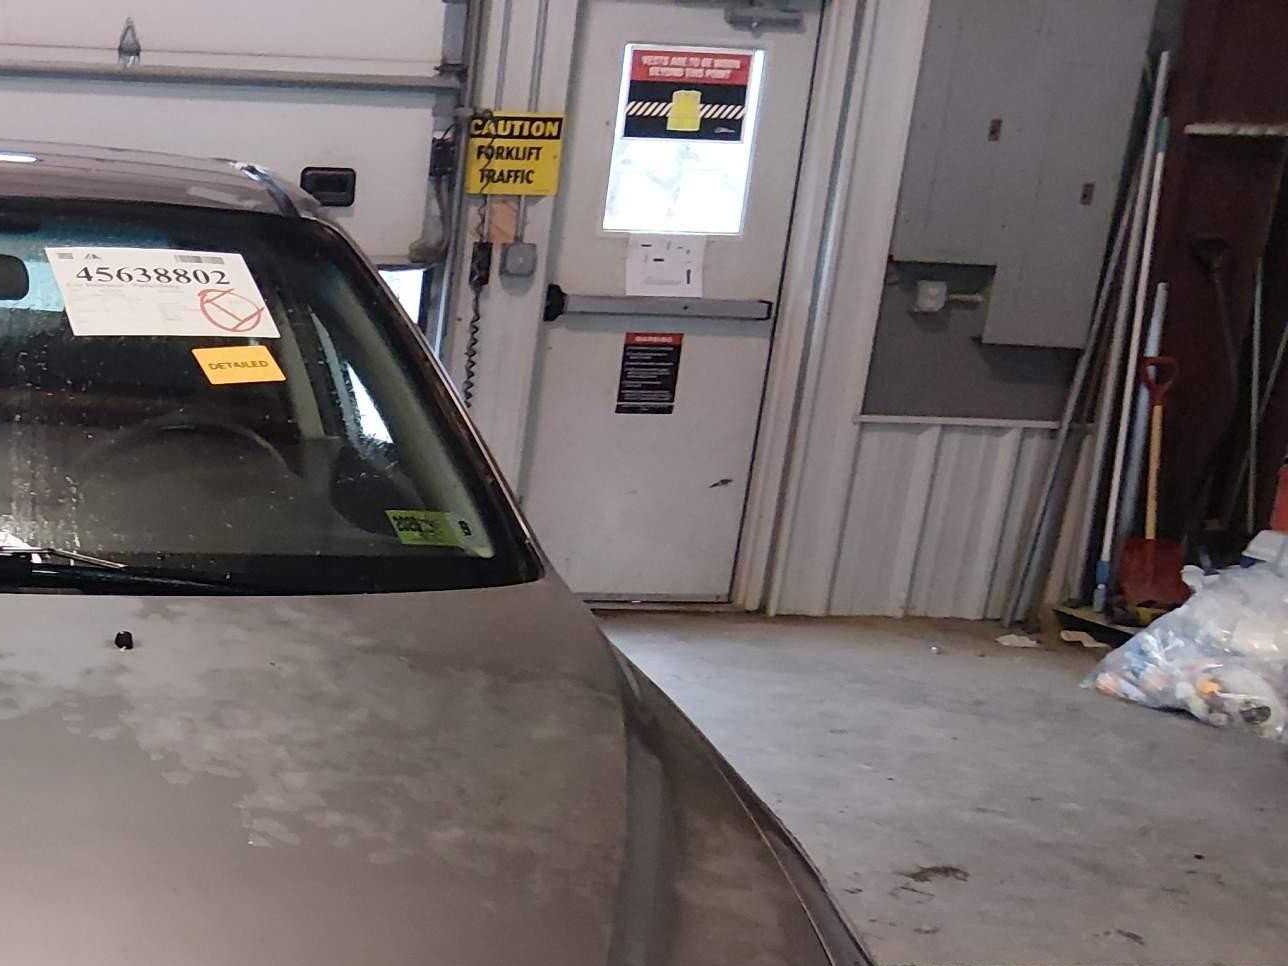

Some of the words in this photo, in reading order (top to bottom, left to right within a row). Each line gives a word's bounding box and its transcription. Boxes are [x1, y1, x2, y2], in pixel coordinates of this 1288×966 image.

[471, 119, 560, 136] CAUTION
[476, 145, 543, 161] FORKLIFT
[479, 168, 535, 184] TRAFFIC
[76, 266, 231, 286] 45638802
[208, 360, 269, 371] DETAILED
